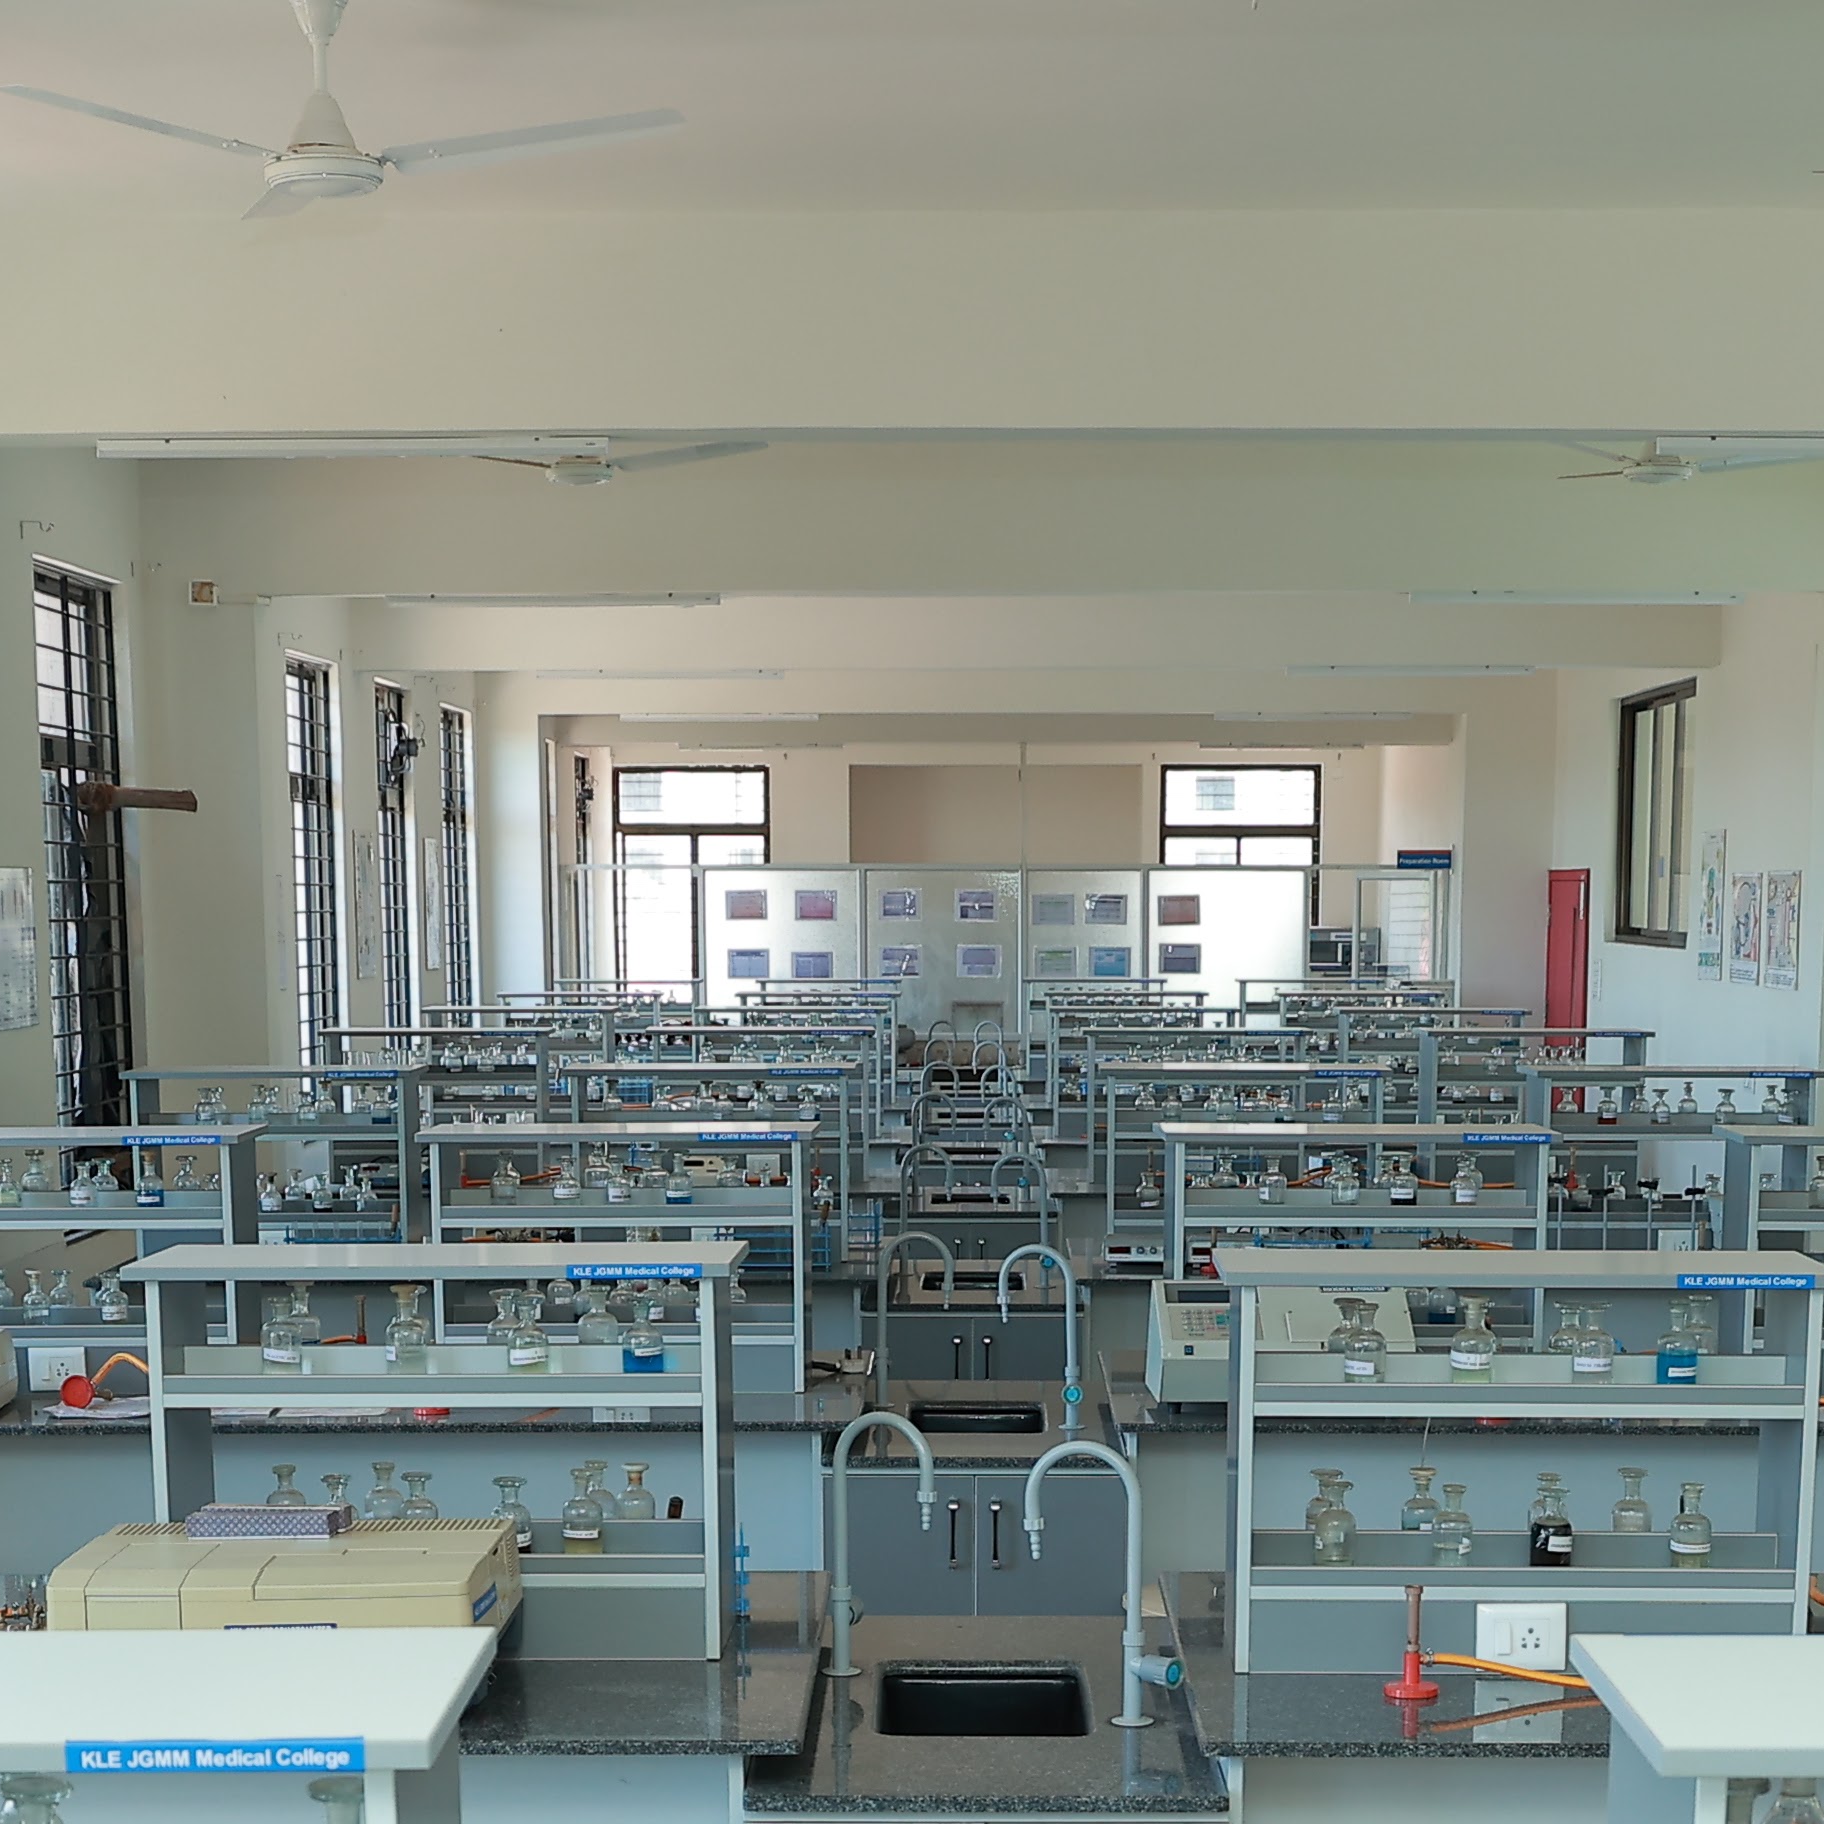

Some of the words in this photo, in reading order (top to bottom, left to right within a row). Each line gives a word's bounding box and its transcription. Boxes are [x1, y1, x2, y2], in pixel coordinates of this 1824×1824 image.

[573, 1268, 591, 1276] KLE
[594, 1267, 622, 1276] JGMM
[624, 1267, 659, 1275] Medical
[661, 1266, 695, 1276] College
[1684, 1278, 1703, 1286] KLE
[1705, 1278, 1734, 1286] JGMM
[1736, 1277, 1771, 1286] Medical
[1773, 1277, 1807, 1287] College
[80, 1751, 122, 1768] KLE
[126, 1750, 191, 1768] JGMM
[196, 1749, 273, 1767] Medical
[276, 1747, 350, 1770] College
